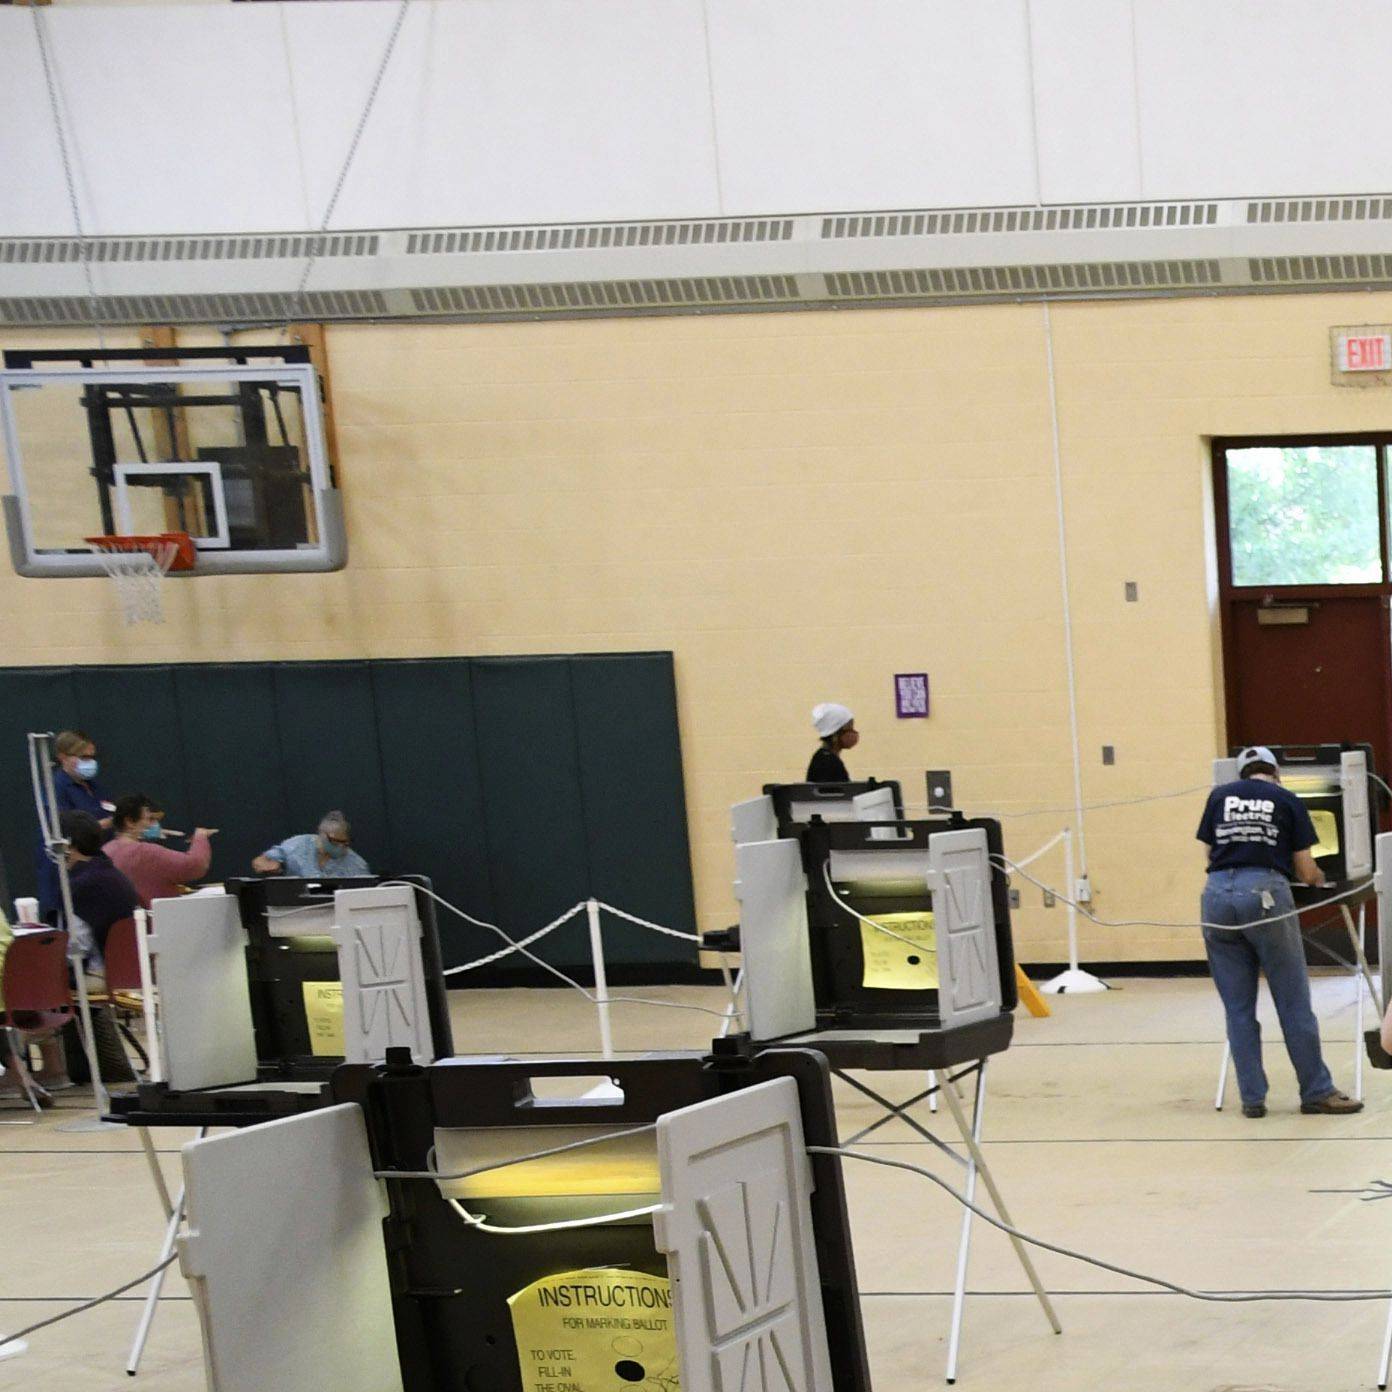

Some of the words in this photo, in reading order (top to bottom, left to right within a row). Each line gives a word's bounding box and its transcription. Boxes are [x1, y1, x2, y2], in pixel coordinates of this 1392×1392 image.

[1347, 338, 1384, 369] EXIT
[1224, 796, 1275, 813] Prue
[1224, 811, 1273, 822] Electric
[562, 1317, 583, 1329] FOR
[586, 1317, 631, 1330] MARKING
[633, 1319, 668, 1330] BALLOT
[531, 1349, 546, 1361] TO
[538, 1366, 572, 1378] FILL-IN
[557, 1383, 584, 1392] OVAL
